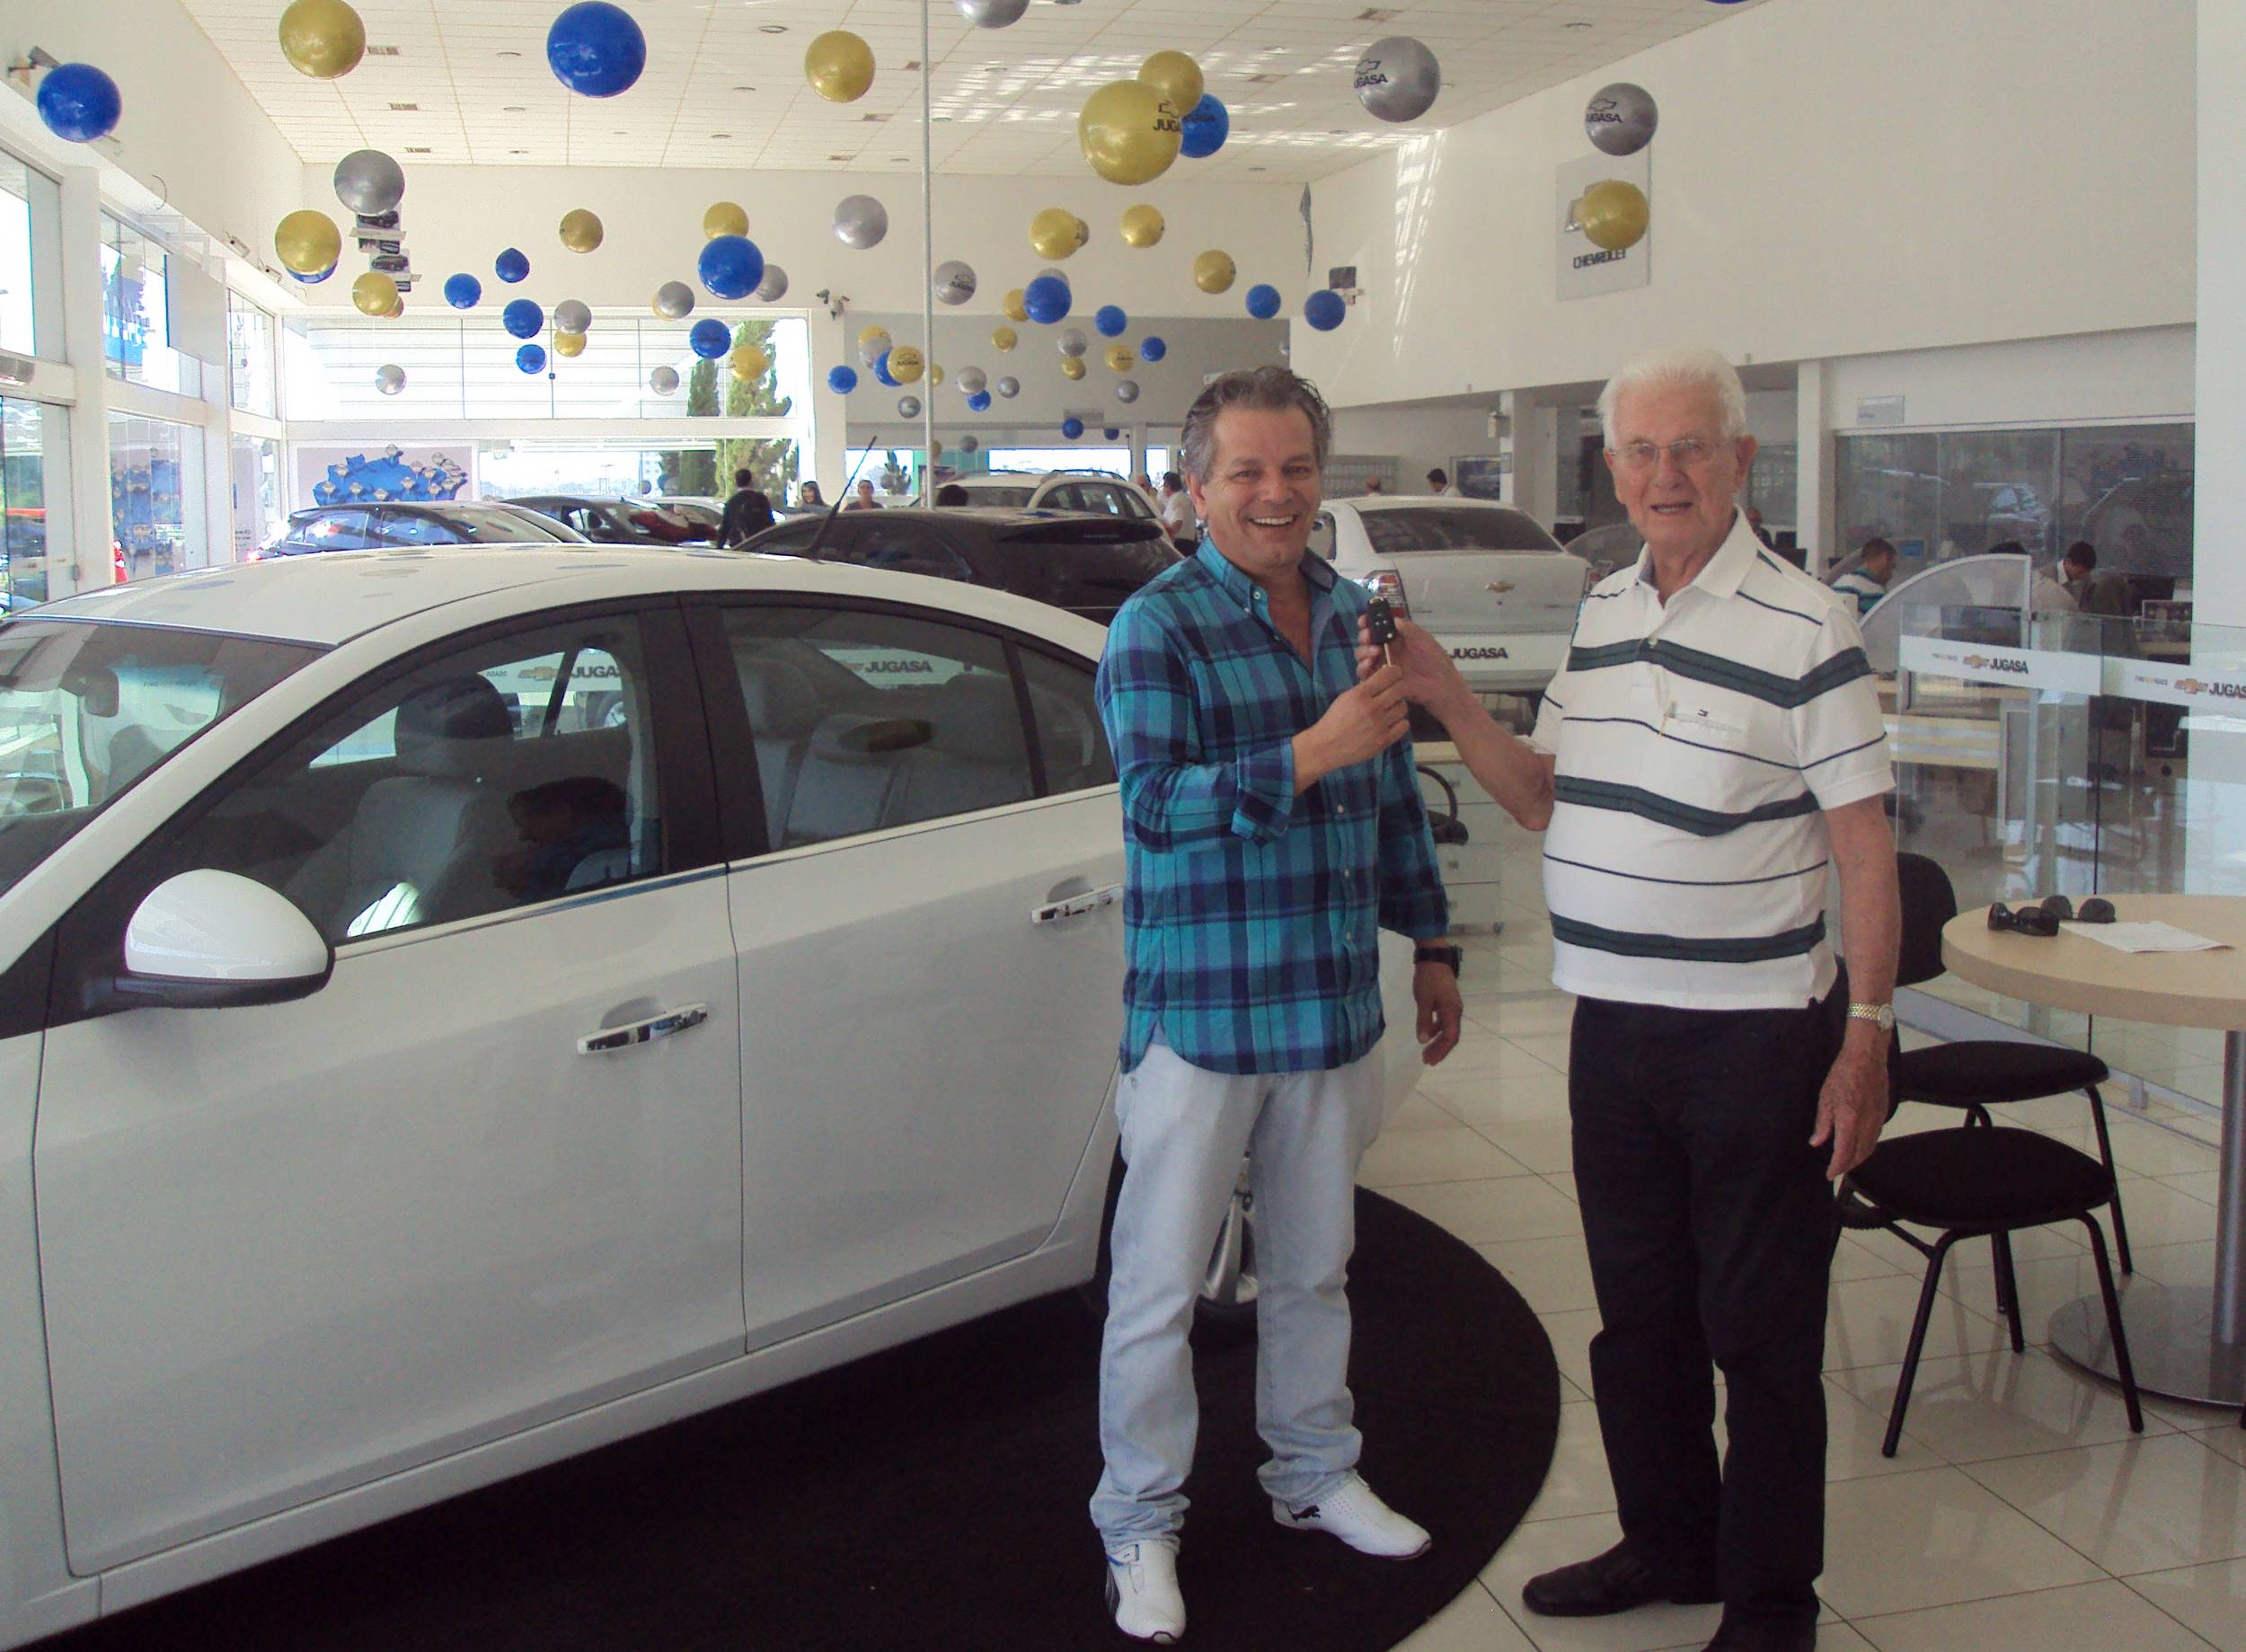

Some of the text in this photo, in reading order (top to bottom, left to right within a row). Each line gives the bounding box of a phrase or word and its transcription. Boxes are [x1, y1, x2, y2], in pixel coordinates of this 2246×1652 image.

[1354, 74, 1388, 88] UGASA
[1450, 648, 1508, 658] JUGASA
[865, 660, 933, 672] JUGASA
[1989, 658, 2029, 674] JUGASA
